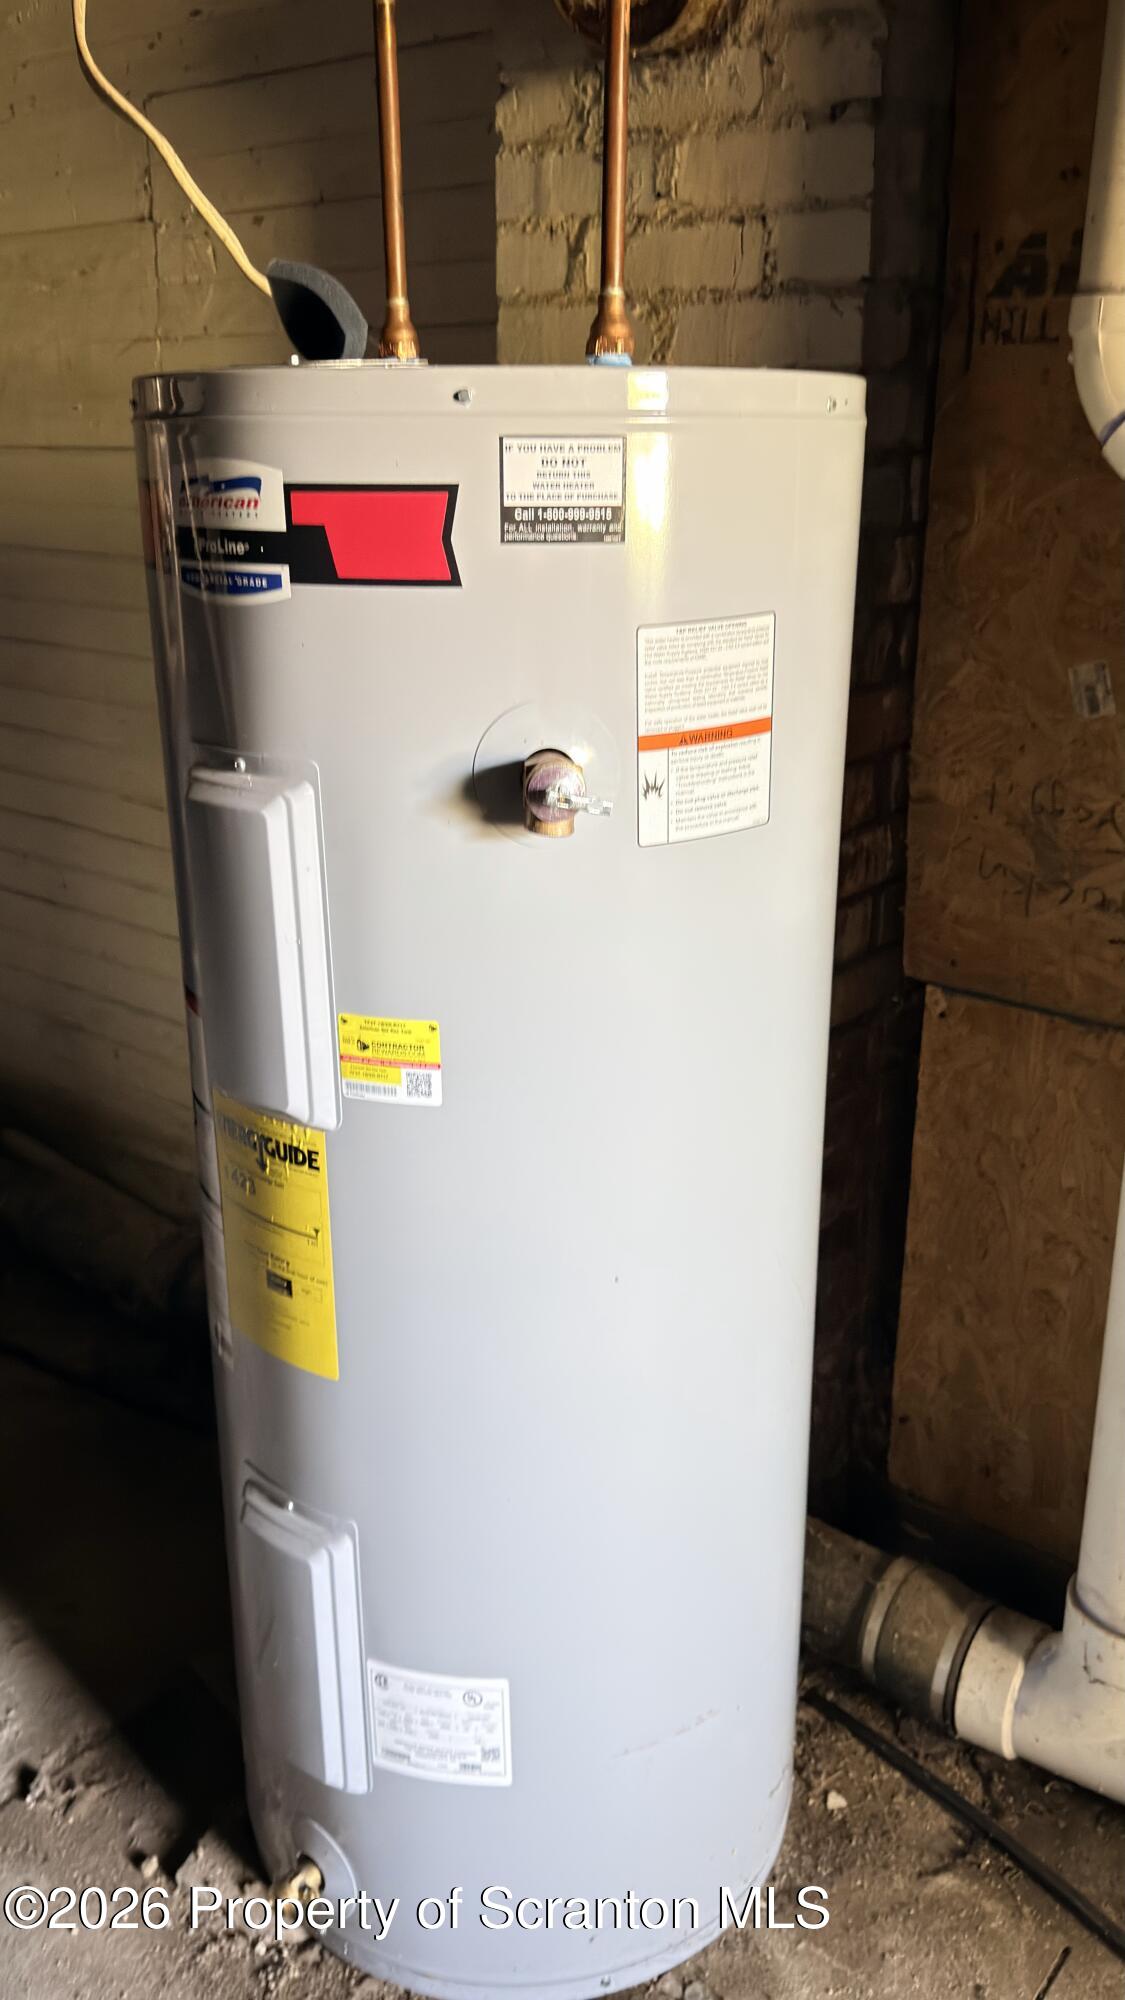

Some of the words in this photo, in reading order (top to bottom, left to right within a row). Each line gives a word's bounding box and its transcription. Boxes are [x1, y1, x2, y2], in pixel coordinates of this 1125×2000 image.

[505, 443, 513, 453] IF
[517, 443, 536, 453] YOU
[540, 443, 565, 453] HAVE
[568, 443, 574, 453] A
[577, 443, 621, 453] PROBLEM
[541, 456, 558, 468] DO
[562, 456, 585, 468] NOT
[537, 470, 570, 479] RETURN
[573, 470, 590, 479] THIS
[533, 481, 561, 490] WATER
[563, 481, 595, 490] HEATER
[506, 492, 516, 501] TO
[520, 492, 534, 501] THE
[537, 492, 561, 501] PLACE
[564, 492, 573, 501] OF
[515, 507, 534, 521] Call
[505, 522, 516, 532] For
[518, 522, 532, 533] ALL
[577, 523, 606, 535] warranty
[689, 728, 733, 744] WARNING
[371, 1041, 424, 1049] CONTRACTOR
